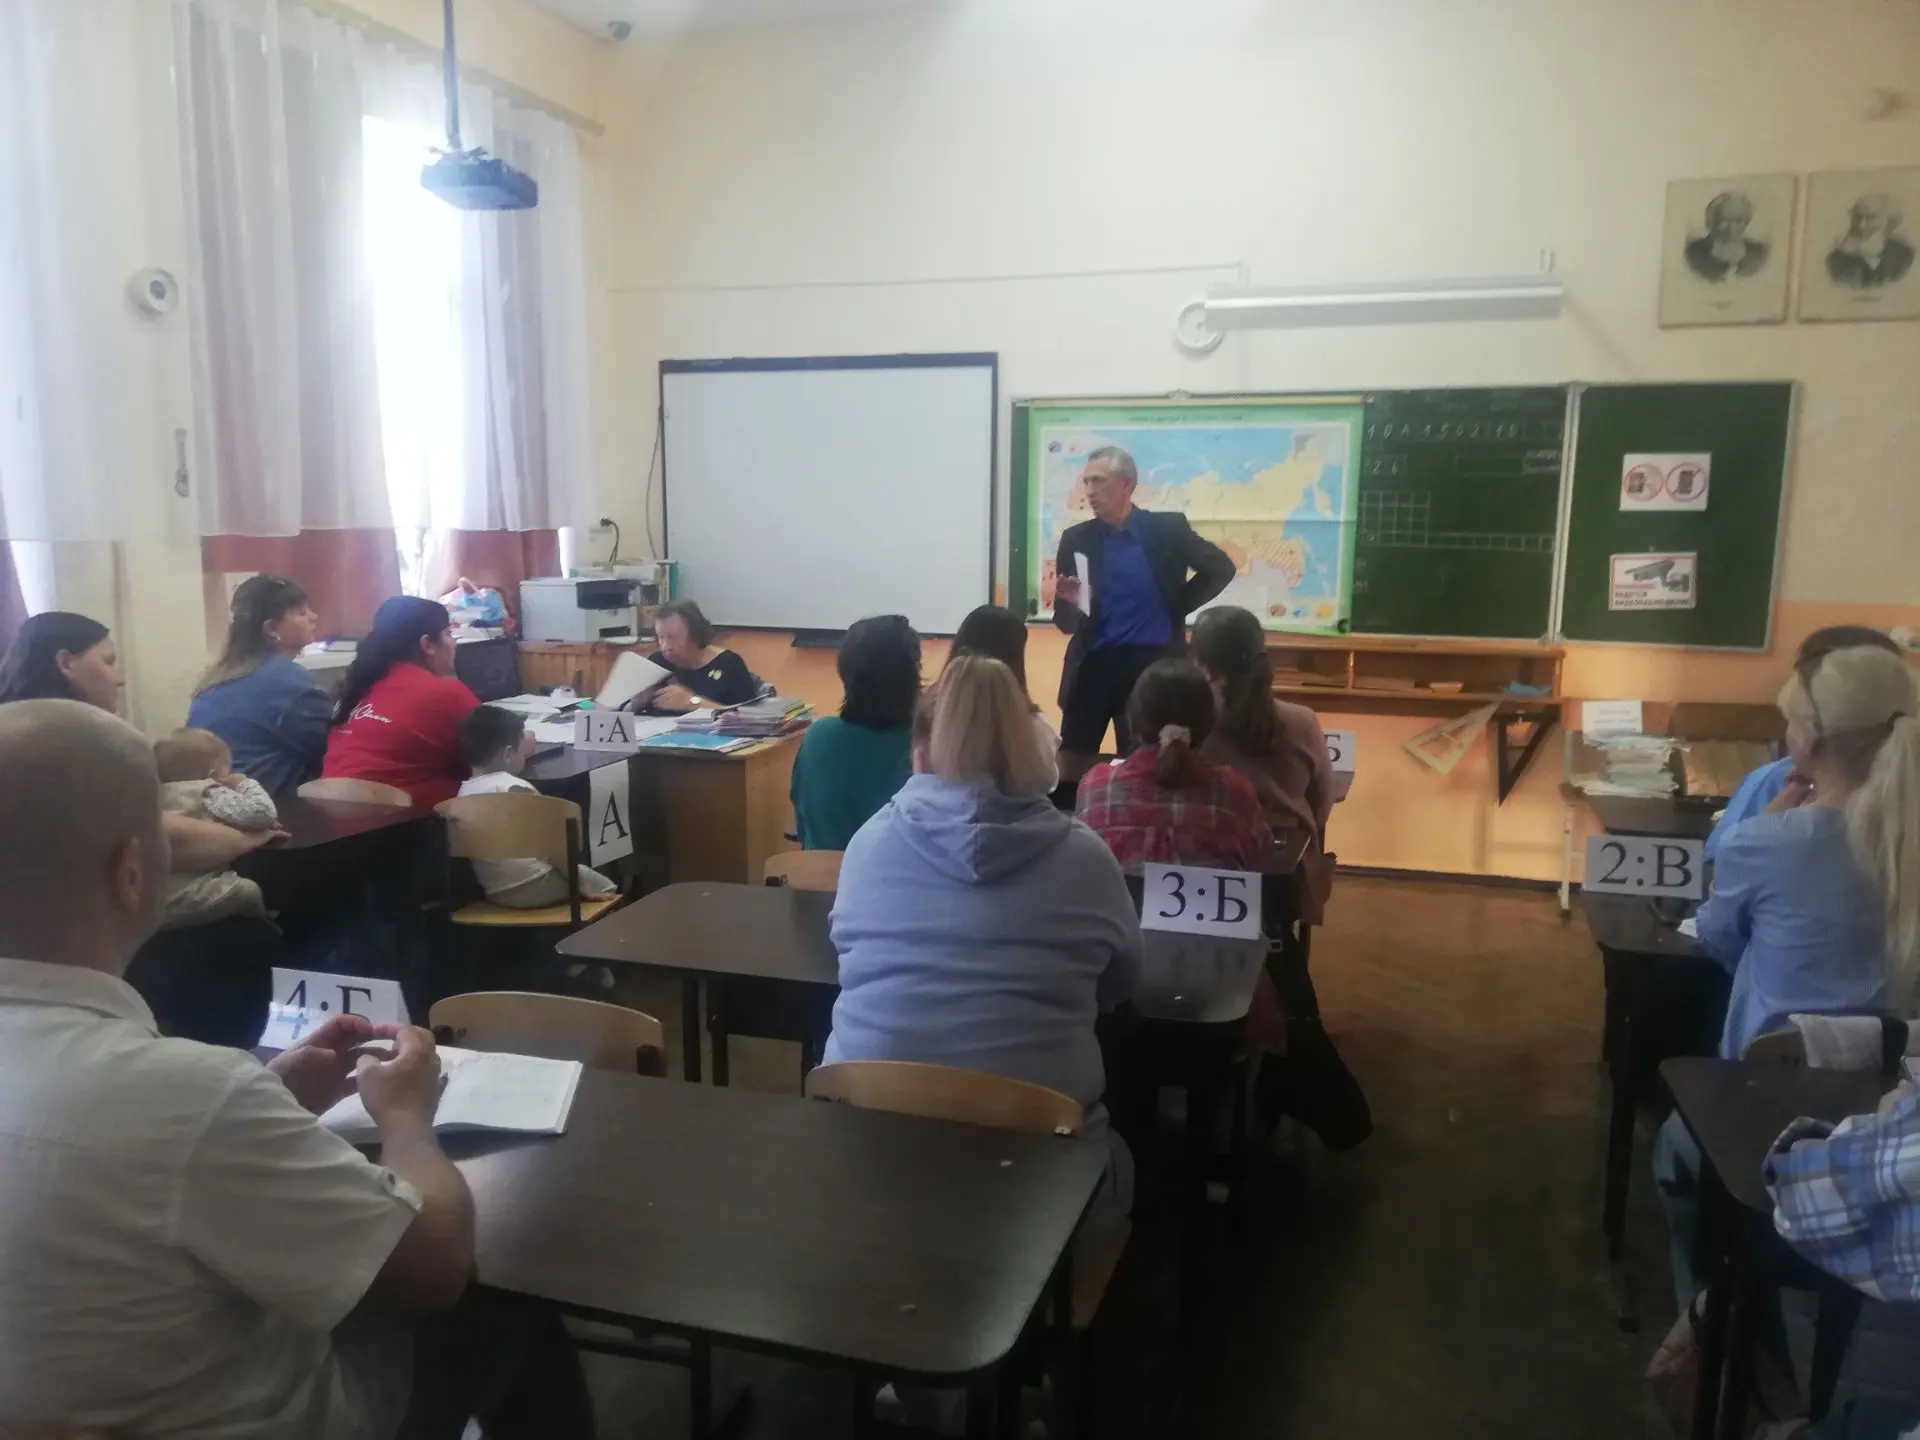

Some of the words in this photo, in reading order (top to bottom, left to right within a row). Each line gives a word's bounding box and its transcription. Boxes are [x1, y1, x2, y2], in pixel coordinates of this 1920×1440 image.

[583, 715, 631, 743] 1:А
[597, 791, 630, 847] А
[1597, 841, 1693, 888] 2:В
[1158, 871, 1249, 923] 3:Б
